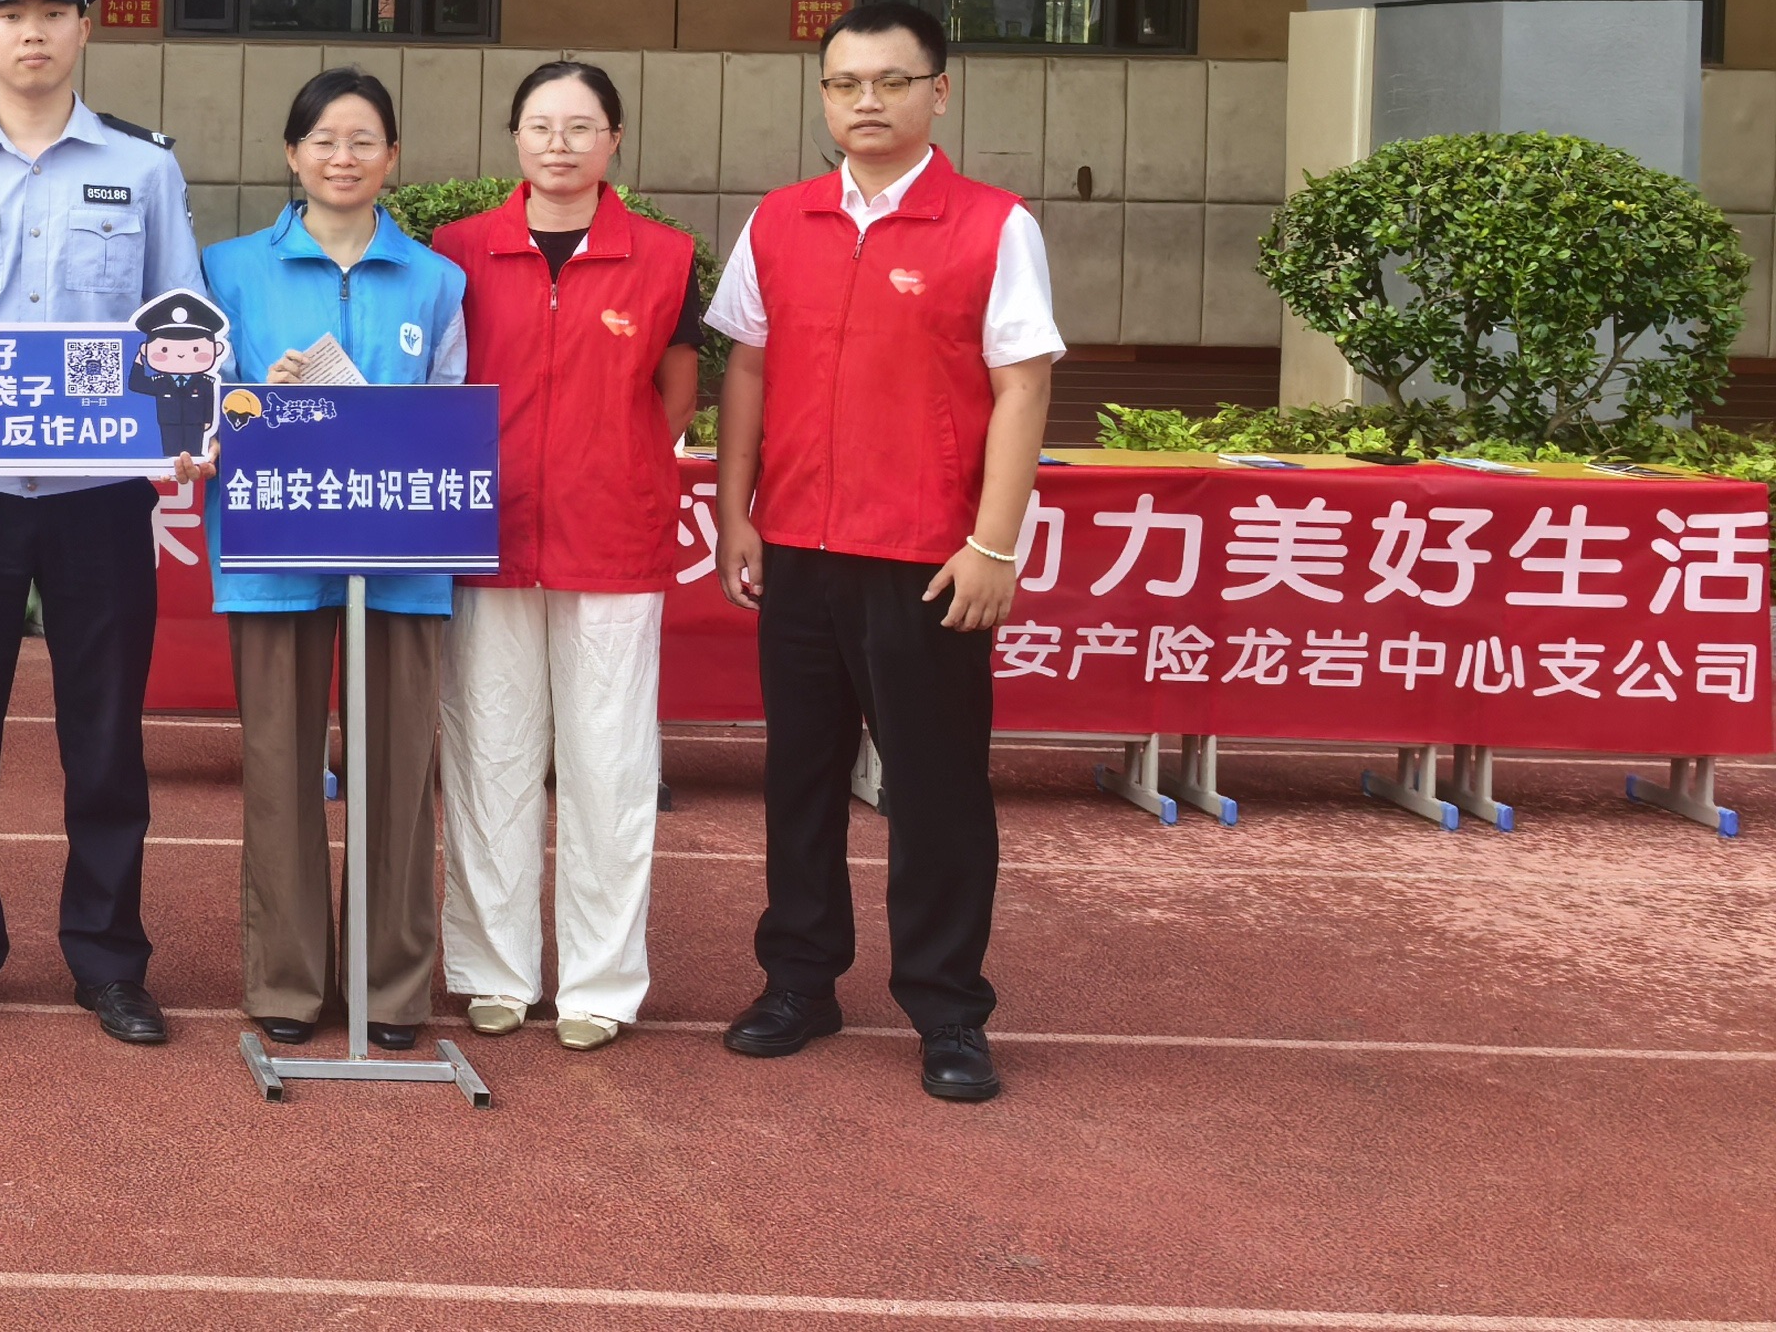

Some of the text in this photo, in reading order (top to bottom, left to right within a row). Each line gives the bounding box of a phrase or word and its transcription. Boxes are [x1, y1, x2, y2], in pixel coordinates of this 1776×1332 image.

[87, 187, 127, 201] 850186
[226, 469, 494, 512] 金融安全知识宣传区
[993, 621, 1757, 704] 安产险龙岩中心支公司
